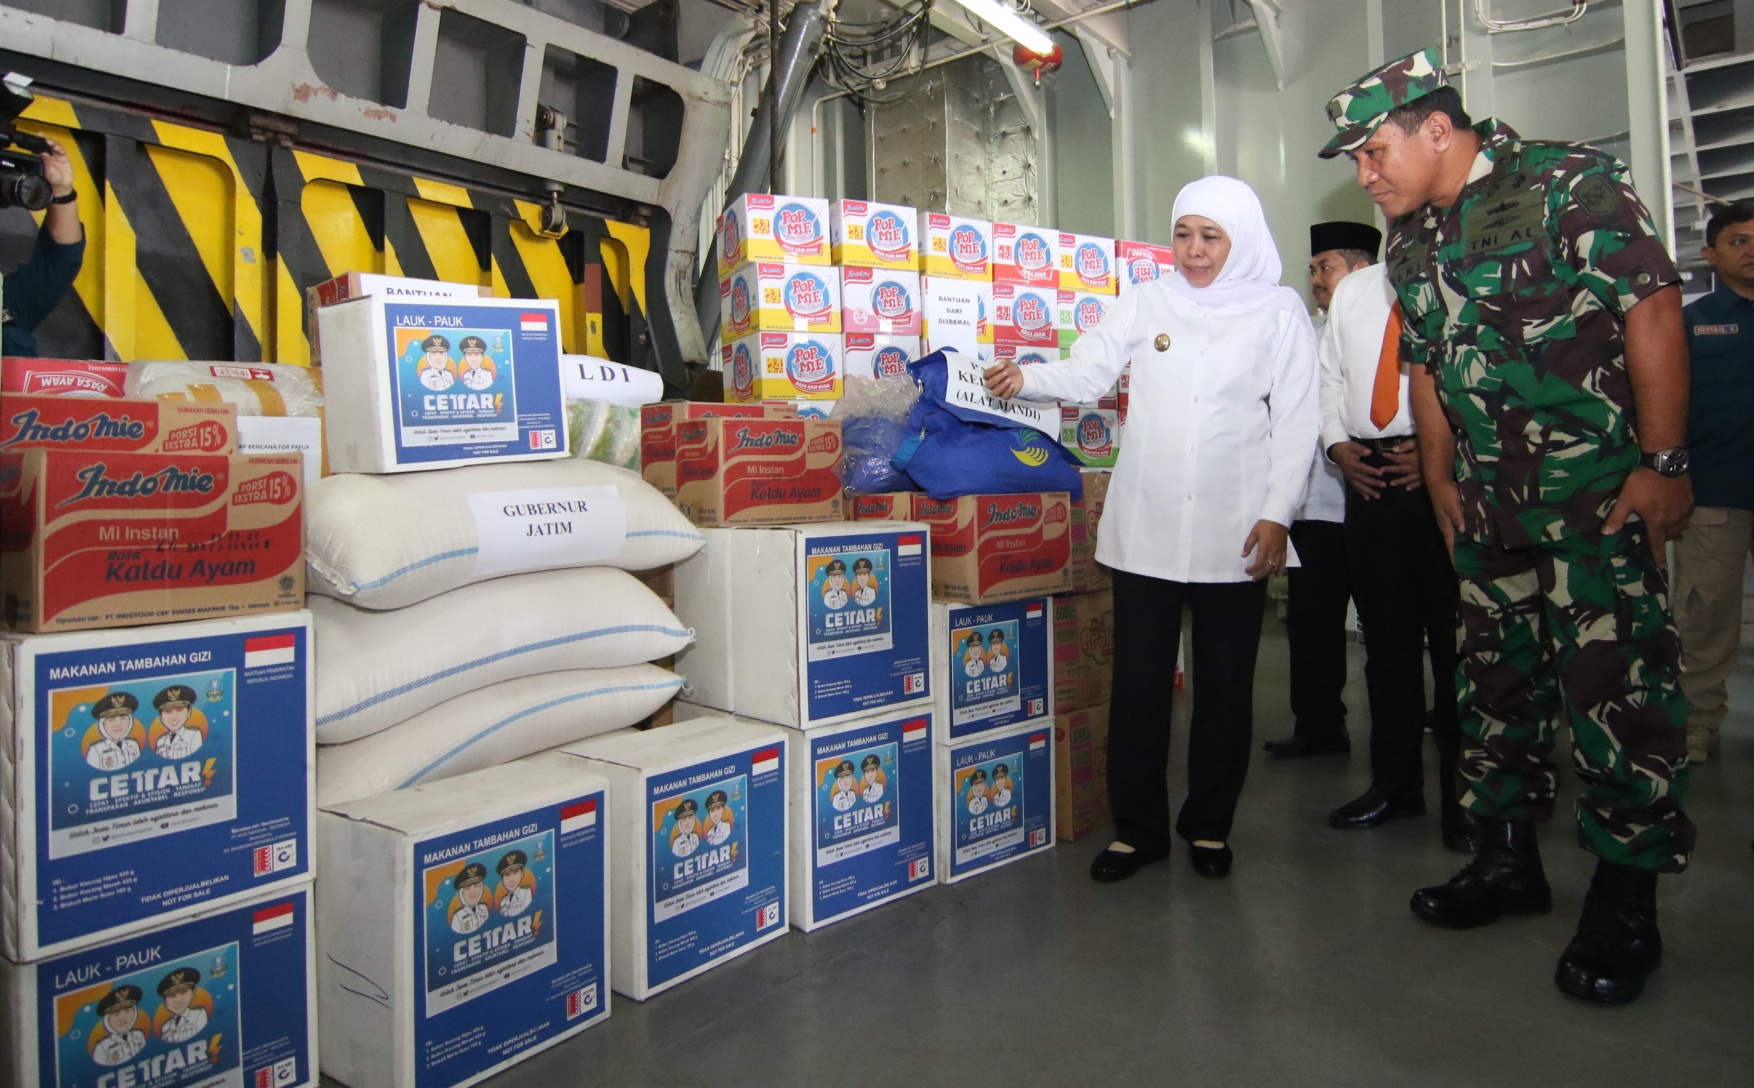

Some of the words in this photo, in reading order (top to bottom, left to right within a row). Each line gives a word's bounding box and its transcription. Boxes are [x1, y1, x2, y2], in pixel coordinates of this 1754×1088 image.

[782, 211, 805, 224] POP
[787, 221, 812, 234] MIE
[874, 218, 894, 231] POP
[878, 229, 900, 241] MIE
[956, 232, 974, 244] POP
[1470, 236, 1498, 250] TNI
[1510, 227, 1537, 240] AL
[960, 242, 979, 254] MIE
[1021, 239, 1039, 251] POP
[999, 249, 1011, 257] 24
[1025, 250, 1044, 260] MIE
[1081, 249, 1097, 259] POP
[1084, 258, 1102, 269] MIE
[793, 280, 815, 293] POP
[879, 287, 897, 299] POP
[797, 291, 821, 303] MIE
[883, 297, 903, 308] MIE
[1020, 300, 1038, 311] POP
[1081, 304, 1097, 315] POP
[396, 315, 425, 326] LAUK
[435, 316, 463, 327] PAUK
[1023, 310, 1043, 320] MIE
[1084, 313, 1102, 324] MIE
[795, 347, 818, 362] POP
[880, 352, 899, 365] POP
[800, 358, 824, 372] MIE
[884, 362, 905, 374] MIE
[42, 377, 74, 386] AYAM
[77, 379, 108, 391] RASA
[795, 381, 807, 389] RASA
[957, 390, 995, 408] (ALAT
[996, 400, 1040, 422] MANDI)
[1082, 420, 1100, 433] POP
[171, 427, 197, 440] PORSI
[199, 423, 222, 448] 15%
[1087, 428, 1105, 441] MIE
[165, 436, 198, 450] EKSTRA
[747, 466, 757, 474] Mi
[760, 465, 784, 474] Instan
[241, 479, 268, 493] PORSI
[269, 476, 290, 499] 15%
[235, 490, 268, 503] EKSTRA
[750, 488, 786, 499] Kaldu
[789, 487, 821, 501] Ayam
[503, 501, 588, 516] GUBERNUR
[100, 526, 120, 540] Mi
[126, 526, 178, 541] Instan
[526, 521, 572, 537] JATIM
[812, 546, 841, 554] MAKANAN
[842, 544, 872, 552] TAMBAHAN
[1006, 540, 1026, 548] Instan
[107, 551, 140, 561] Rasa
[105, 560, 182, 582] Kaldu
[185, 559, 256, 583] Ayam
[1000, 561, 1027, 573] Kaldu
[1030, 558, 1054, 574] Ayam
[116, 611, 154, 619] INDOFOOD
[198, 605, 226, 613] MAKMUR
[955, 617, 972, 627] LAUK
[976, 614, 993, 623] PAUK
[50, 662, 116, 680] MAKANAN
[119, 654, 186, 671] TAMBAHAN
[189, 651, 211, 663] GIZI
[817, 741, 846, 754] MAKANAN
[847, 735, 877, 748] TAMBAHAN
[878, 732, 888, 741] GIZI
[956, 756, 974, 766] LAUK
[979, 749, 996, 760] PAUK
[654, 778, 687, 795] MAKANAN
[689, 769, 723, 786] TAMBAHAN
[724, 765, 736, 775] GIZI
[86, 802, 129, 815] TRANSPARAN
[134, 795, 168, 806] AKUNTABEL
[174, 787, 206, 798] RESPONSIF
[89, 800, 109, 808] CEPAT
[114, 794, 140, 804] EFEKTIF
[147, 788, 170, 798] EFISIEN
[176, 782, 202, 791] TANGGAP
[424, 841, 471, 864] MAKANAN
[473, 828, 520, 850] TAMBAHAN
[522, 823, 538, 836] GIZI
[140, 892, 162, 903] TIDAK
[163, 875, 229, 898] DIPERJUALBELIKAN
[162, 898, 176, 907] NOT
[178, 894, 192, 903] FOR
[194, 889, 211, 899] SALE
[55, 963, 101, 989] LAUK
[115, 945, 162, 972] PAUK
[488, 1043, 502, 1054] TIDAK
[502, 1047, 512, 1055] NOT
[514, 1041, 523, 1050] FOR
[525, 1035, 537, 1045] SALE
